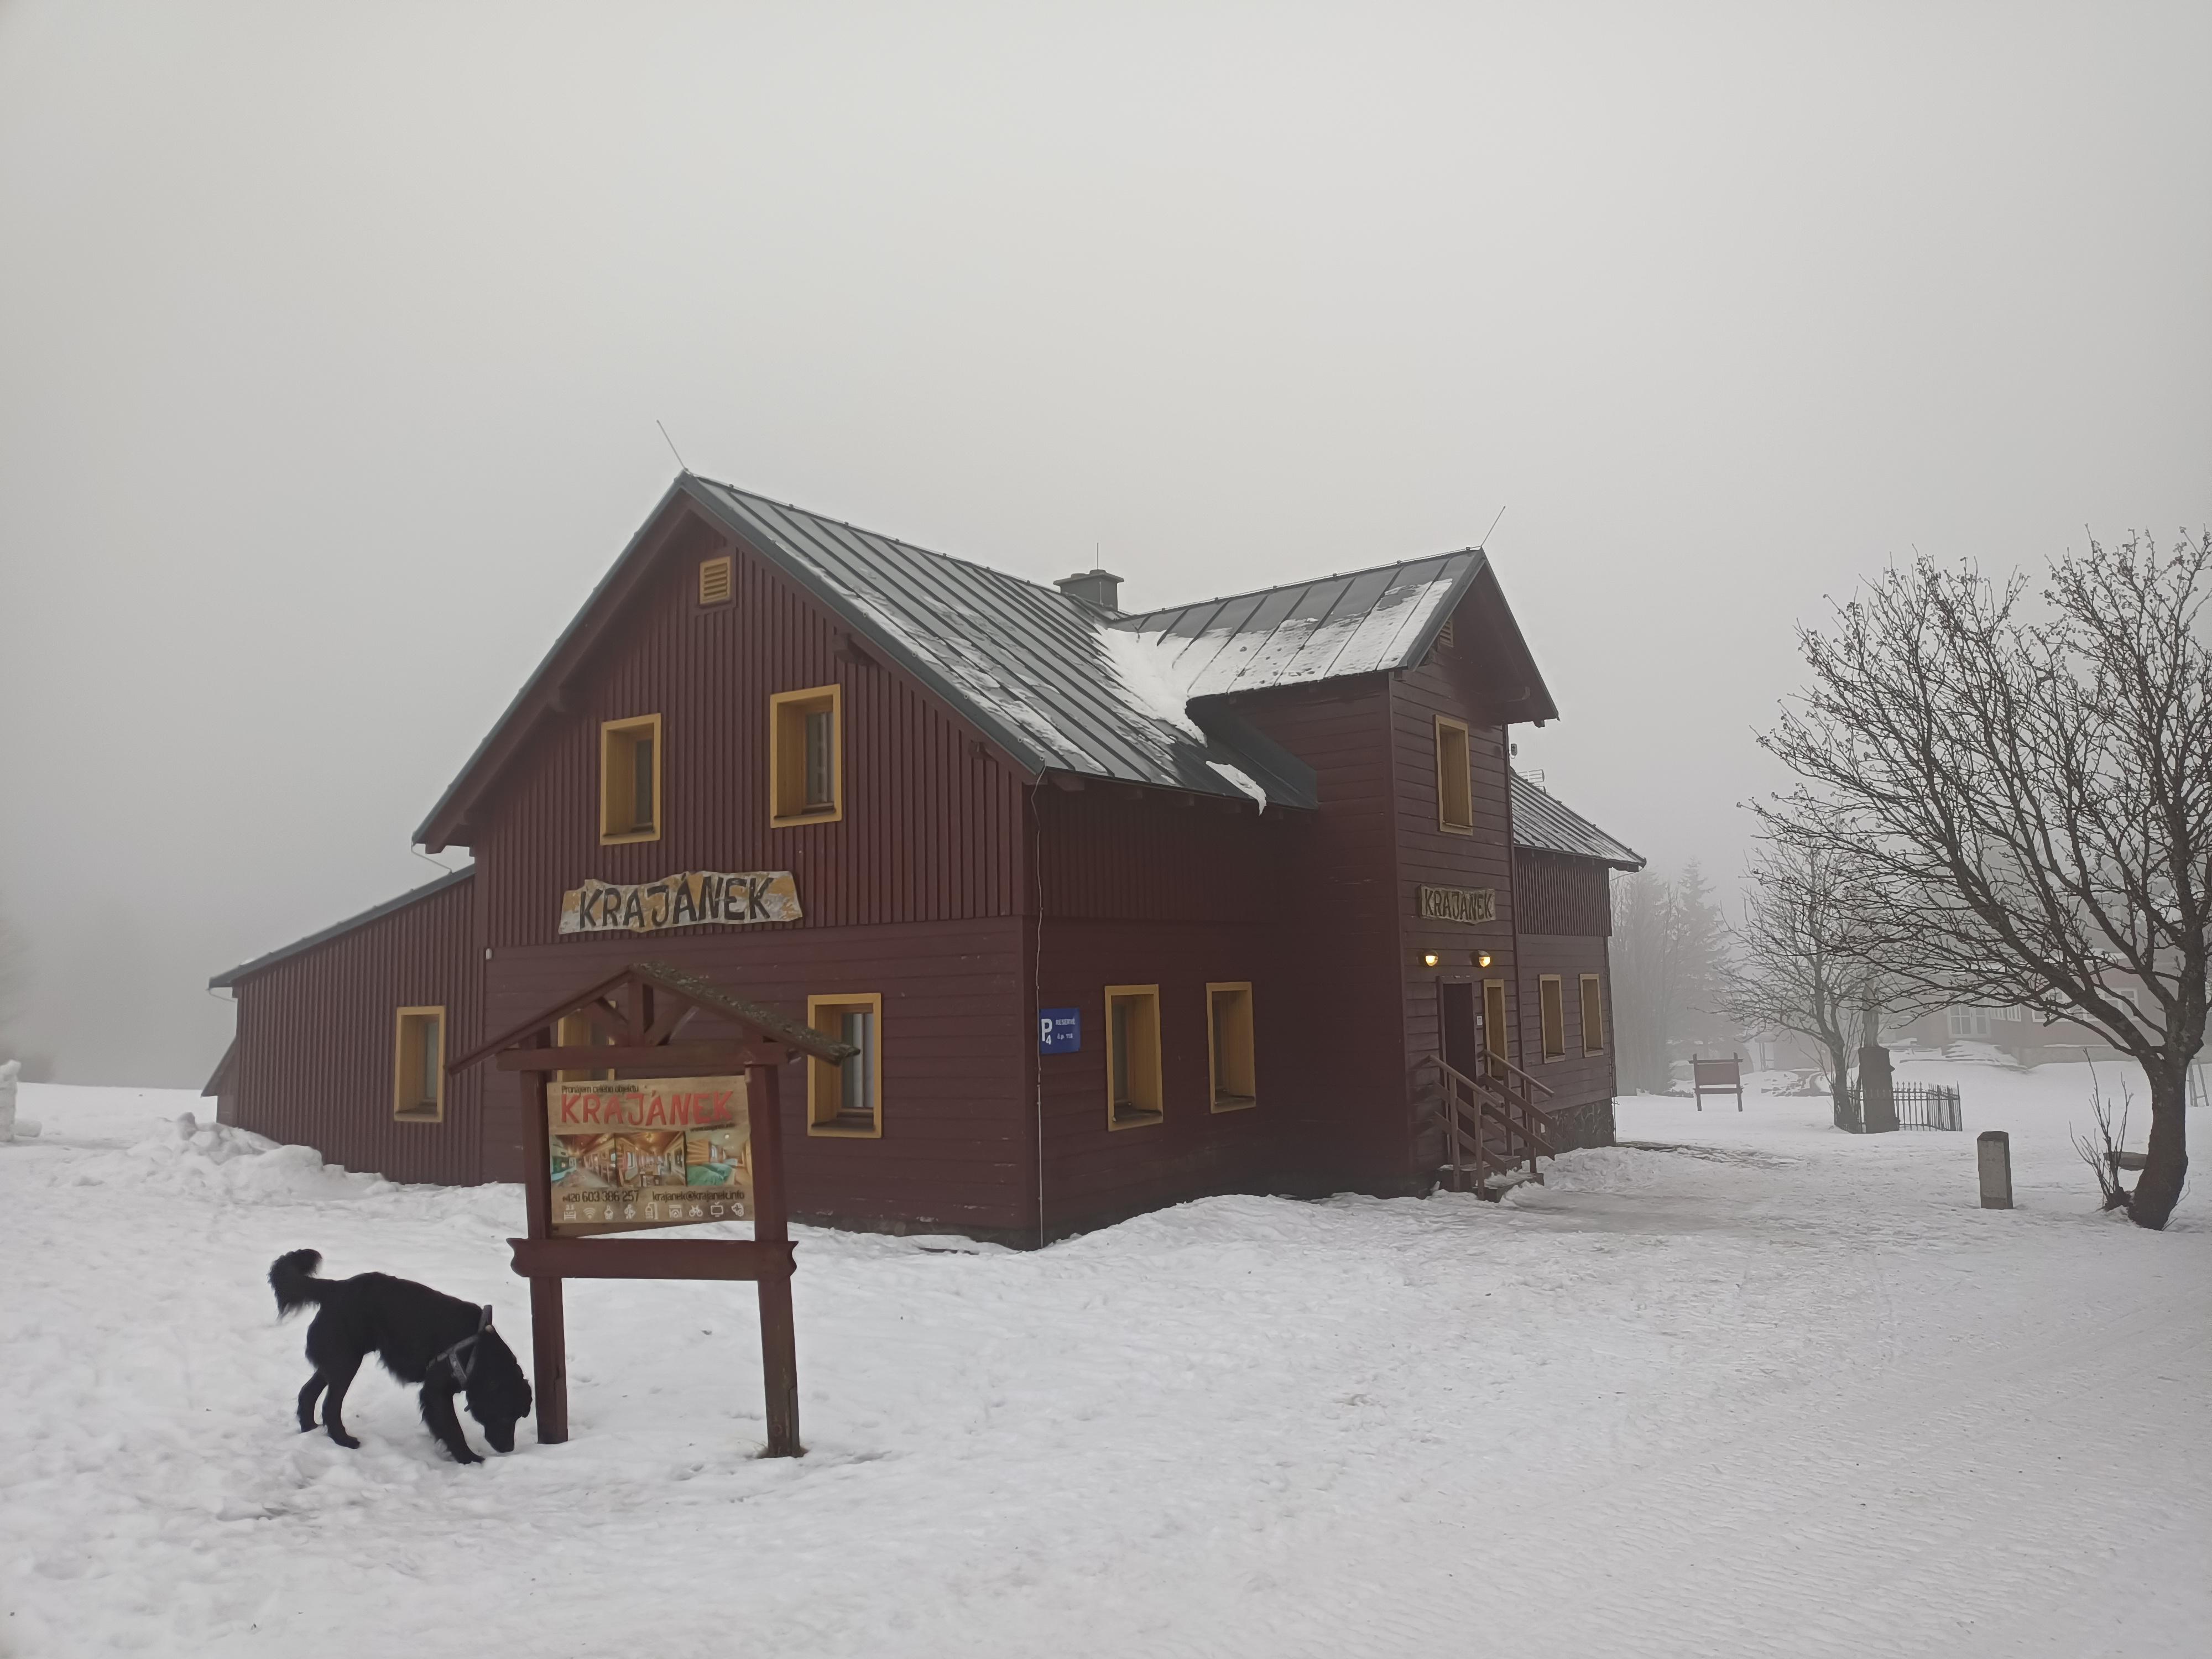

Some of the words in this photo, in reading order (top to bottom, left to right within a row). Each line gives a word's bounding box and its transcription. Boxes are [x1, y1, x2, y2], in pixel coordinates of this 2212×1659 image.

[580, 873, 774, 928] KRAJÁNEK
[1041, 1019, 1052, 1041] P
[561, 1090, 733, 1126] KRAJÁNEK
[582, 1191, 600, 1203] 603
[622, 1190, 639, 1202] 257
